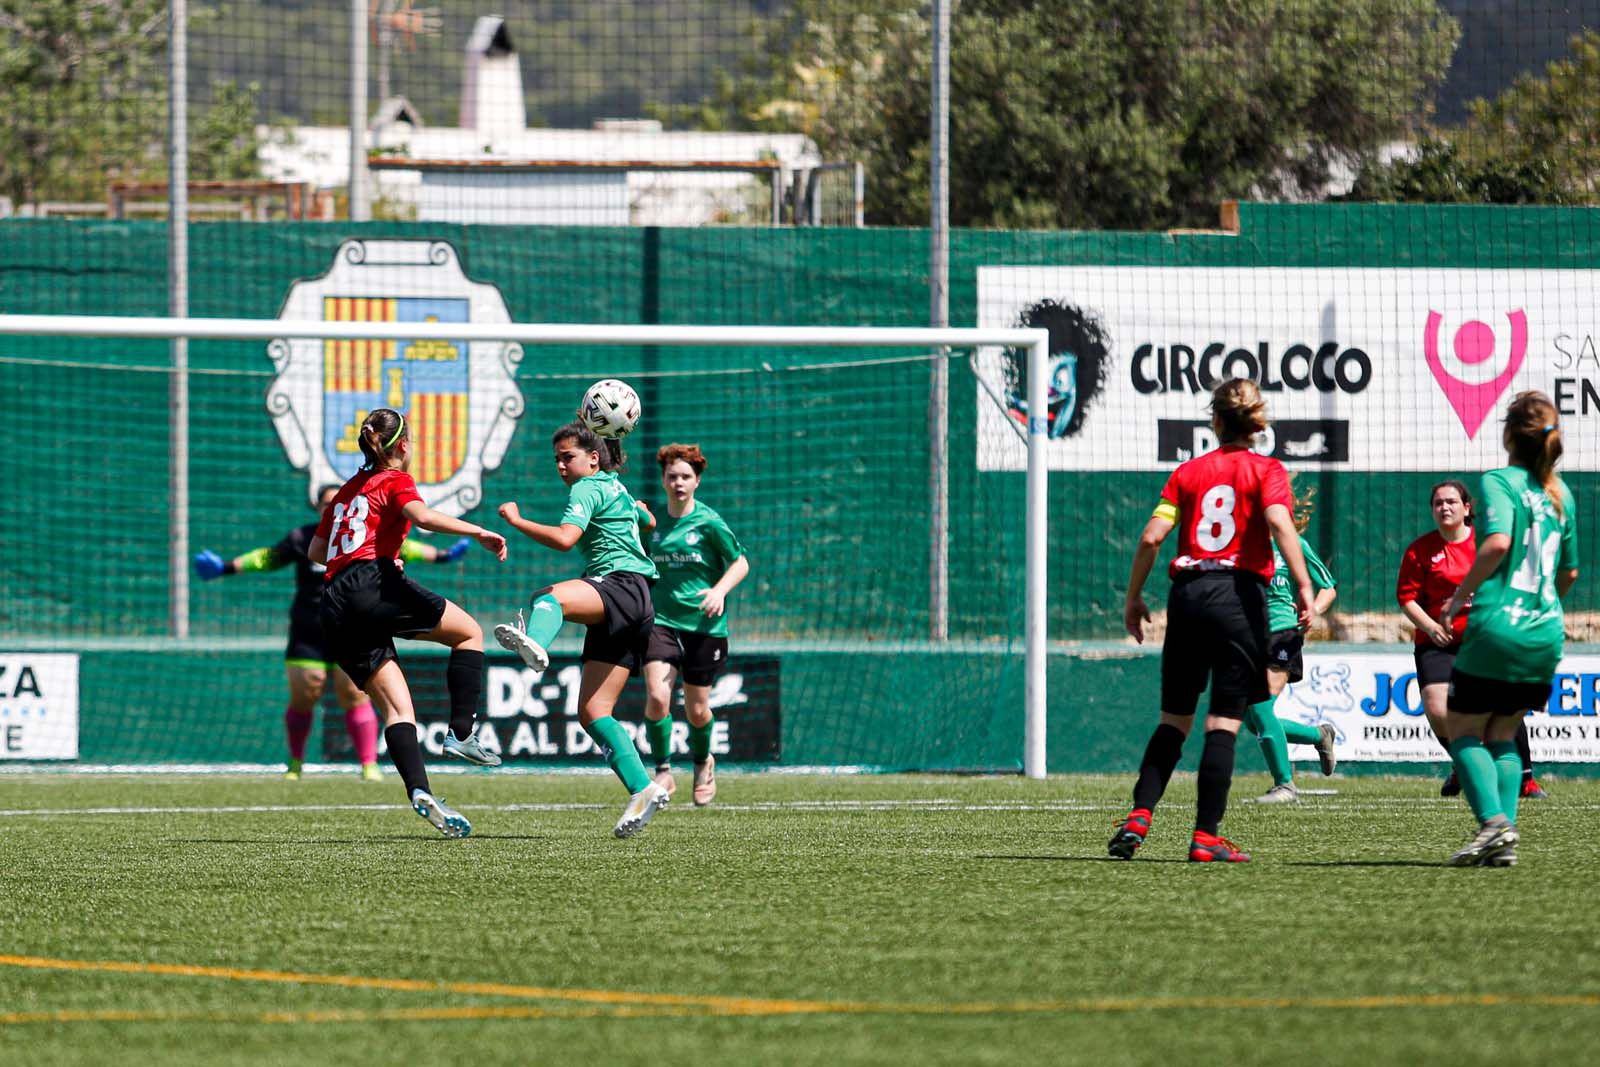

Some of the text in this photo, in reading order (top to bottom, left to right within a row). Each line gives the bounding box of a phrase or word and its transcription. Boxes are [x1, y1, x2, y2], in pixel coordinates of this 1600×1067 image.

[1130, 341, 1373, 395] CIRCOLOCO
[326, 495, 370, 562] 23
[1196, 484, 1236, 552] 8
[510, 722, 559, 756] AL
